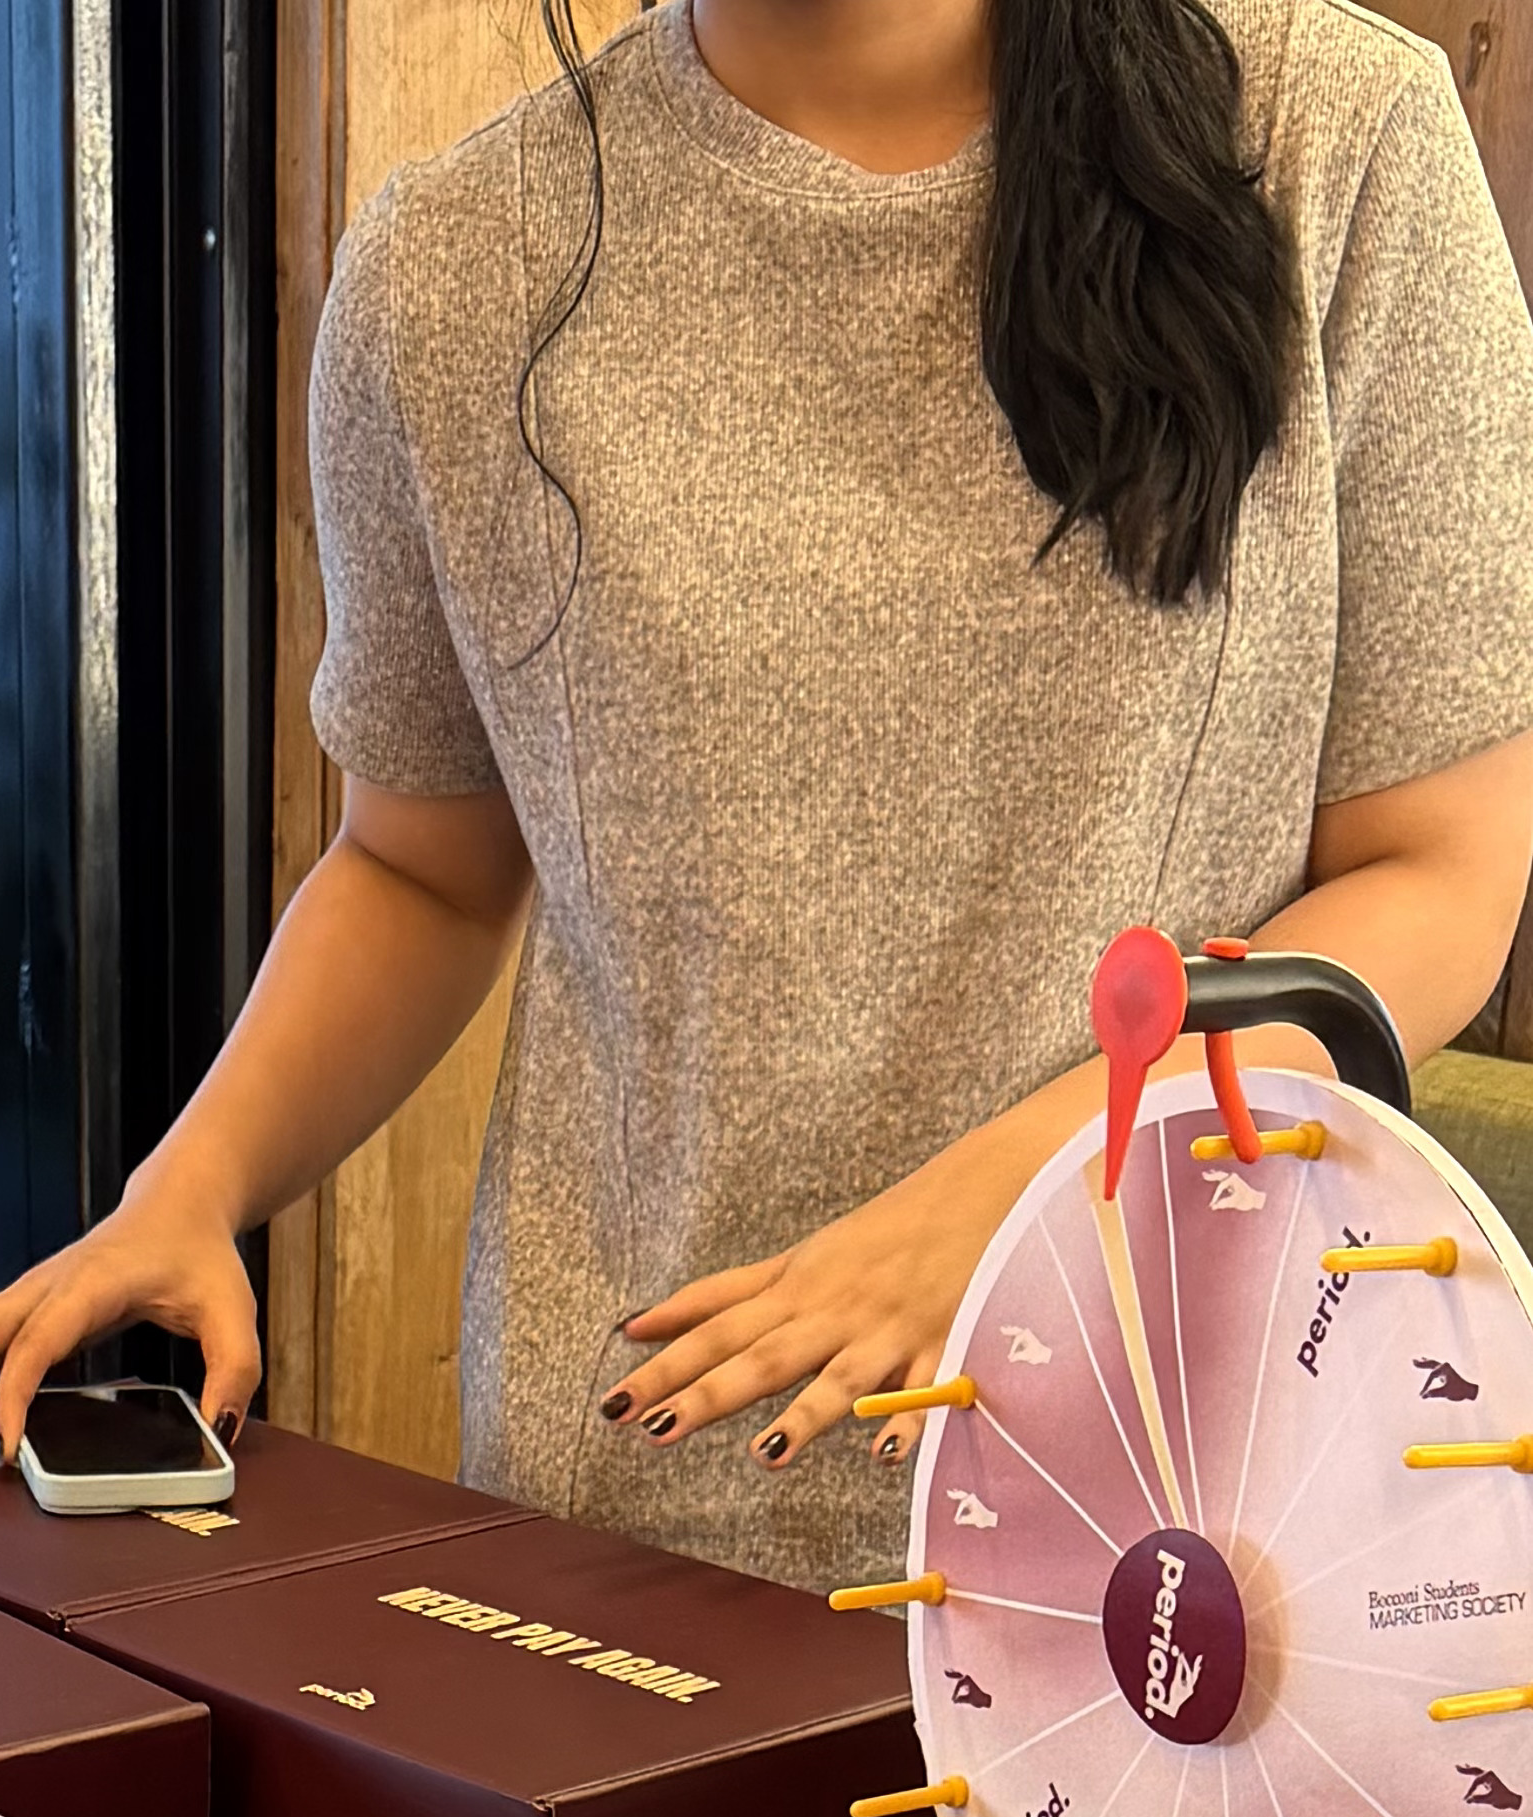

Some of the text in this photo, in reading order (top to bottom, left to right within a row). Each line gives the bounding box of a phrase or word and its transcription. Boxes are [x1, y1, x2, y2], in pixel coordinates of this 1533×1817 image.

[376, 1586, 722, 1704] NEVER PAY AGAIN.
[1145, 1549, 1186, 1720] period.
[1369, 1591, 1527, 1630] MARKETING SOCIETY
